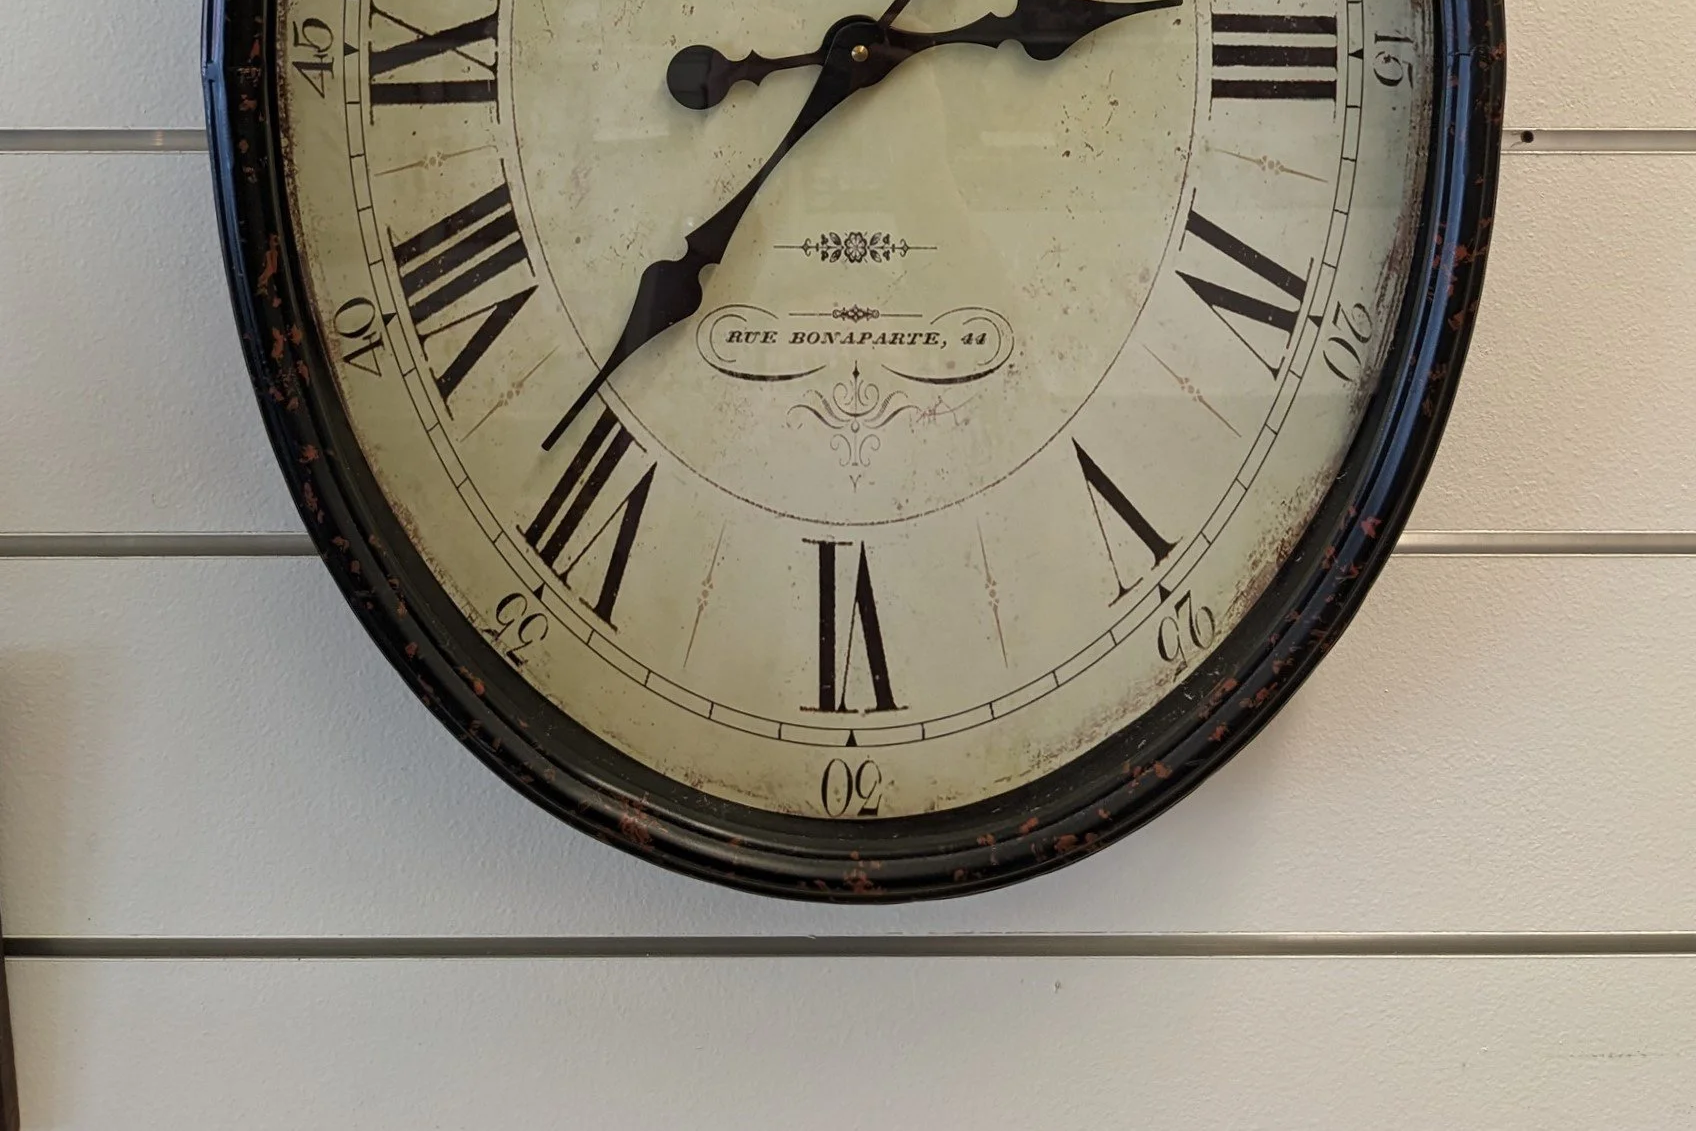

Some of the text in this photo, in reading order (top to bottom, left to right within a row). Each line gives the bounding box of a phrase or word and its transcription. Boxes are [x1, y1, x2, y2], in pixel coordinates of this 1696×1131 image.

[294, 17, 334, 99] 45
[1373, 30, 1415, 89] 15
[387, 157, 540, 421] VIII
[1174, 187, 1316, 381] IV
[333, 296, 383, 377] 40
[726, 330, 988, 349] RUE BONAPARTE, 44
[1322, 301, 1374, 383] 20
[515, 389, 658, 633] VII
[1071, 436, 1183, 607] V
[495, 592, 549, 667] 35
[800, 538, 909, 714] VI
[1157, 590, 1216, 669] 25
[820, 757, 884, 818] 30
